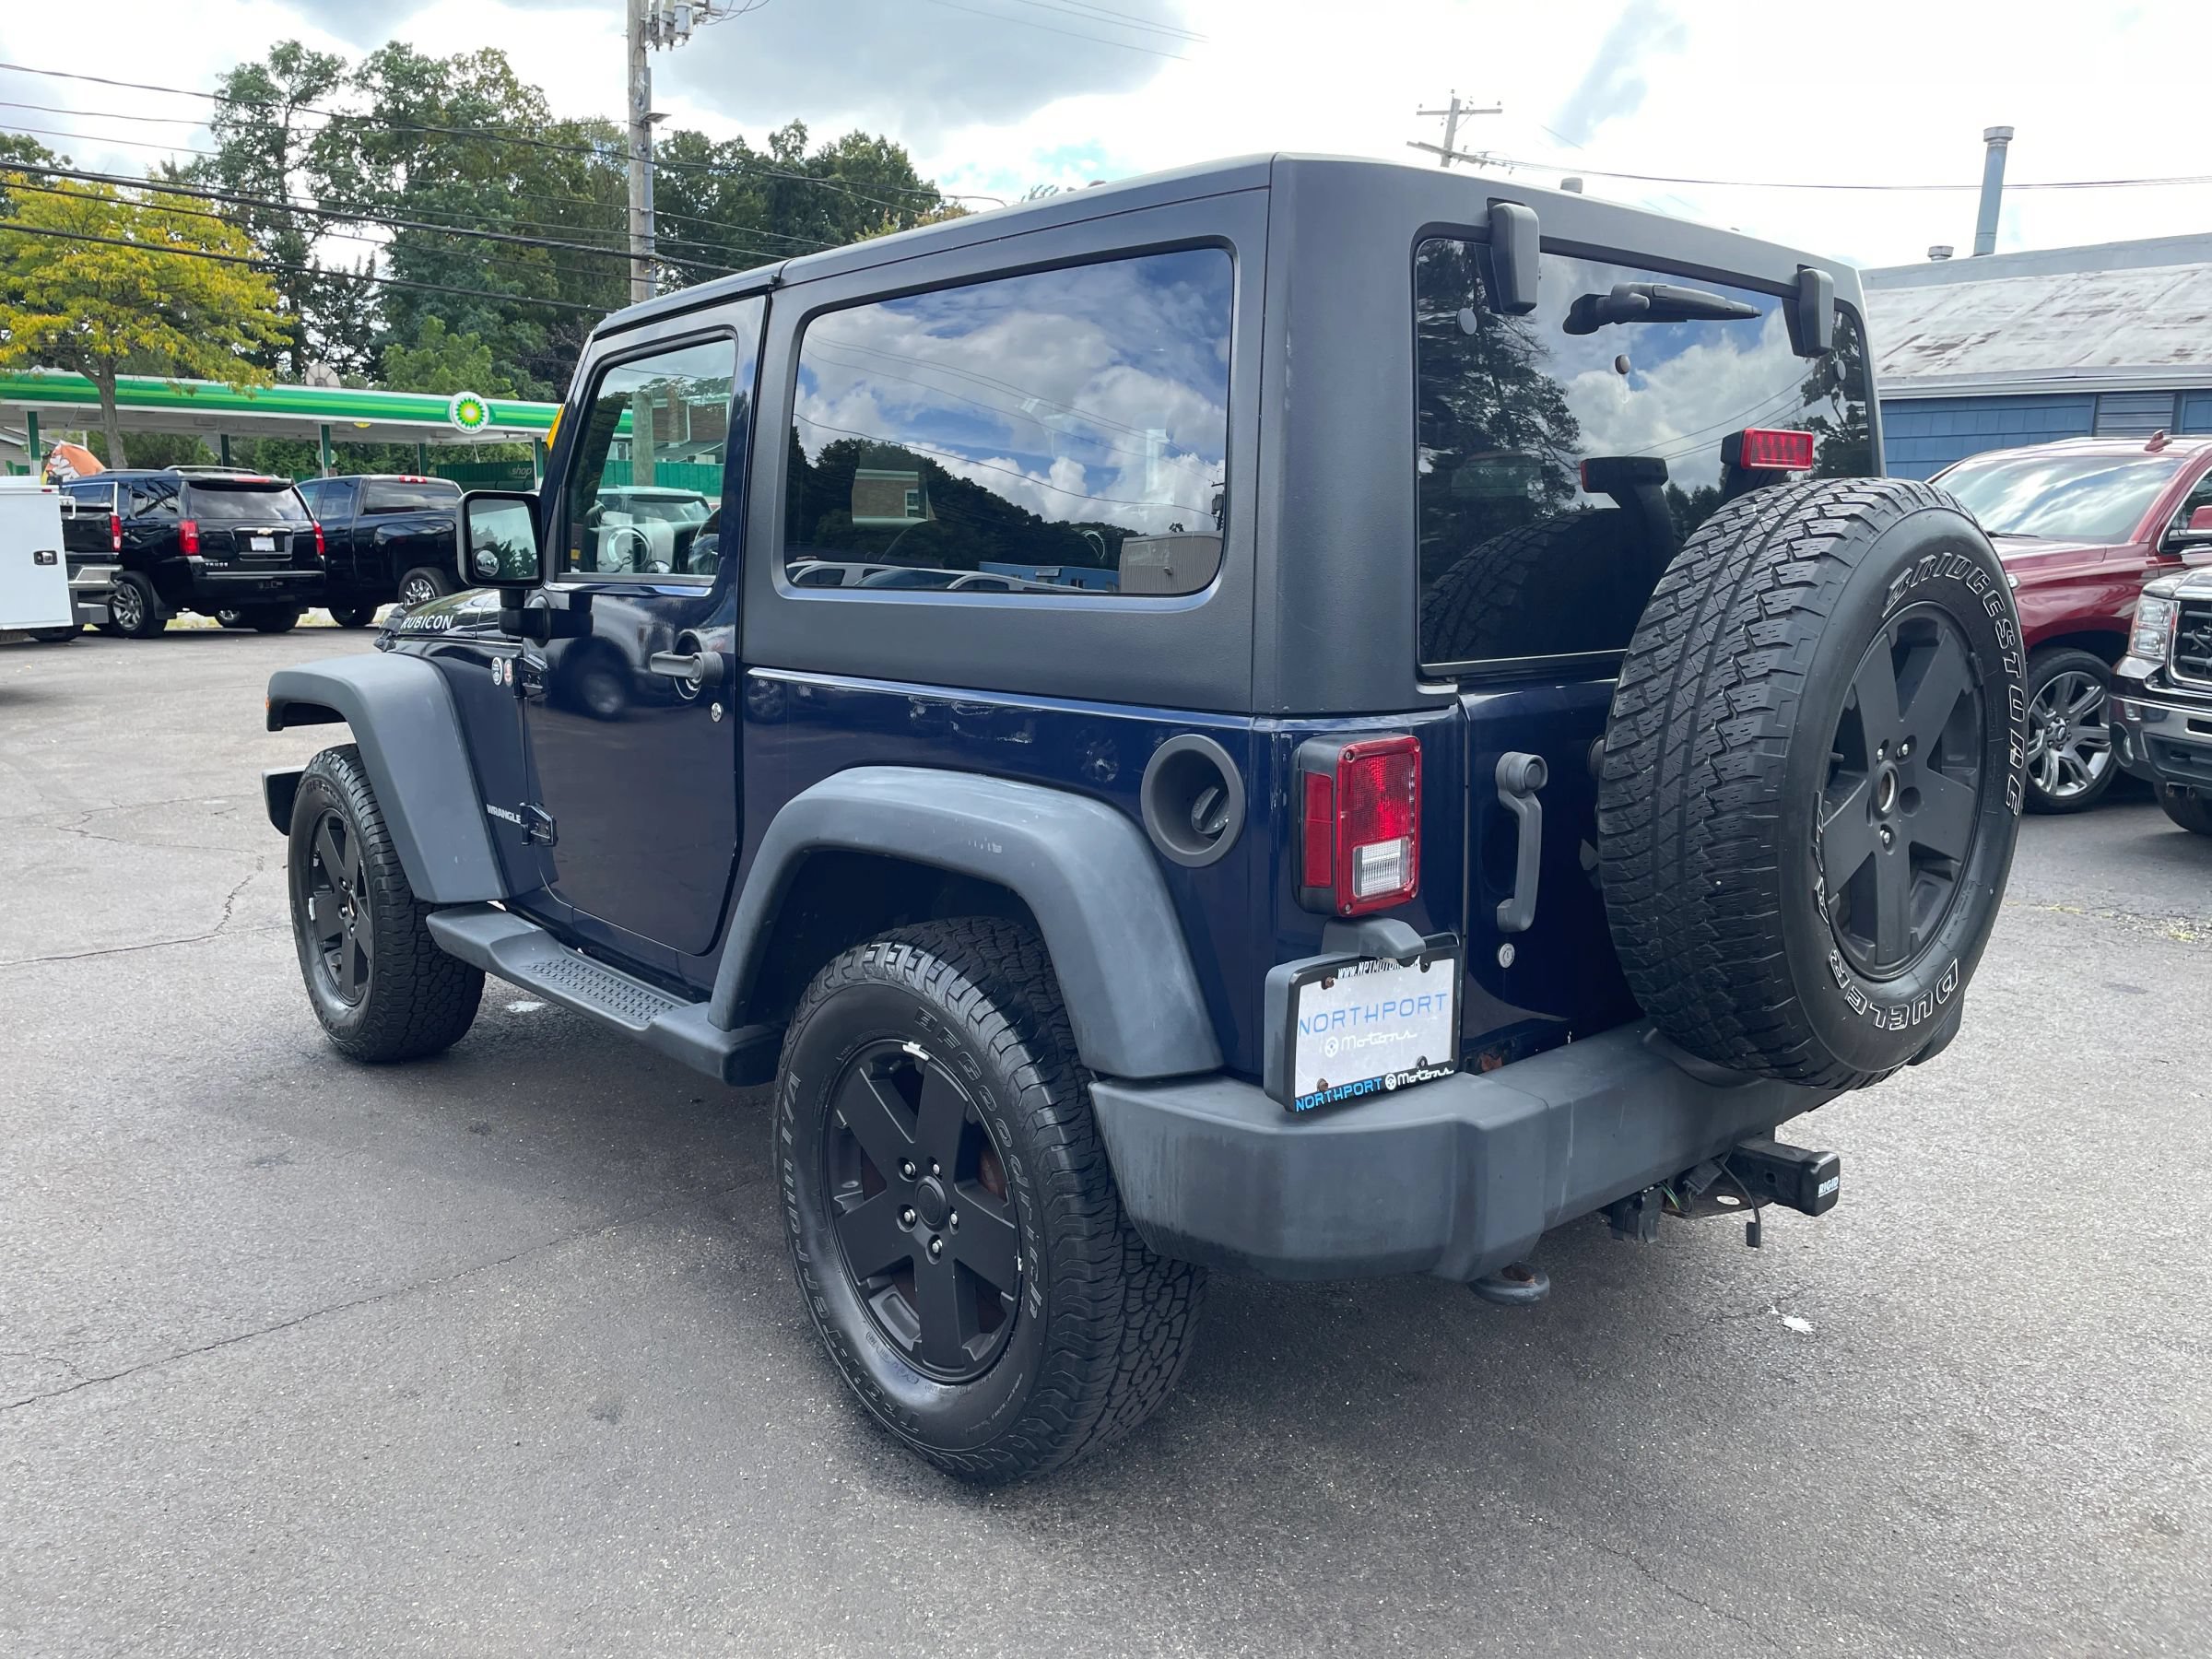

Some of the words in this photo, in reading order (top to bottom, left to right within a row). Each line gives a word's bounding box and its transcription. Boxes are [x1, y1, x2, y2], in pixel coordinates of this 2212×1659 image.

[512, 465, 532, 476] shop
[400, 615, 453, 629] RUBICON
[1881, 552, 2025, 816] BRIDGESTONE
[487, 804, 522, 824] WRANGLE
[1828, 949, 1959, 1031] DUELER
[1298, 993, 1448, 1037] NORTHPORT
[1341, 1029, 1418, 1054] Motors
[1295, 1077, 1382, 1112] NORTHPORT
[1397, 1066, 1454, 1086] Motors
[1818, 1175, 1840, 1196] RIGID
